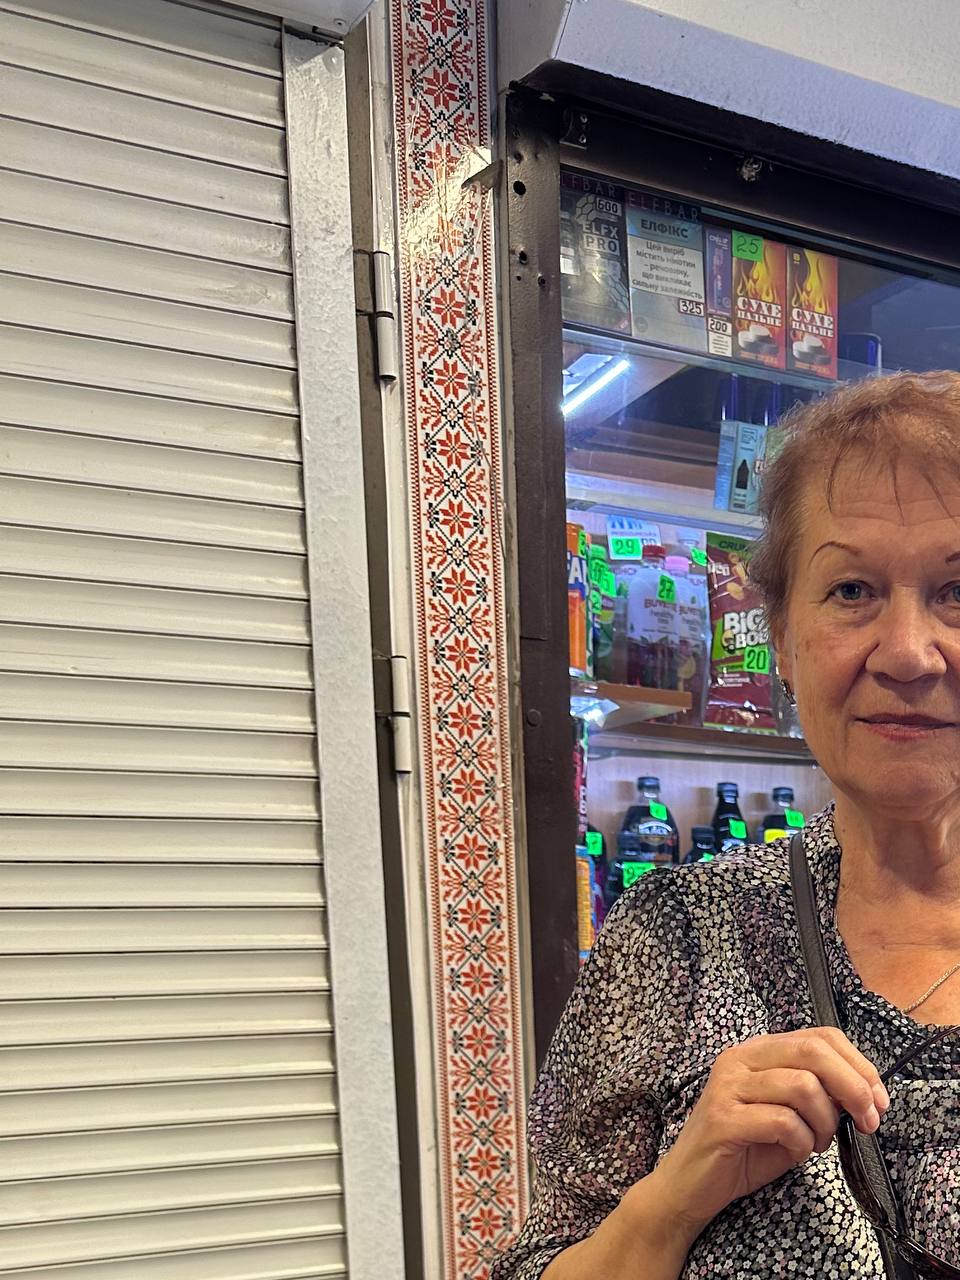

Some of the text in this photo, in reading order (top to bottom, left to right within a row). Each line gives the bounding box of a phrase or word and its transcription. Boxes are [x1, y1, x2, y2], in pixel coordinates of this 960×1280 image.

[560, 175, 616, 198] LFBAR
[582, 222, 618, 239] ELFX
[641, 220, 688, 239] ЕЛФІКС
[585, 235, 617, 253] PRO
[737, 236, 759, 254] 25
[681, 300, 702, 314] 325
[737, 297, 782, 318] СУХЕ
[710, 319, 728, 332] 200
[737, 310, 782, 327] ПАЛЬНЕ
[792, 308, 834, 329] СУХЕ
[792, 321, 834, 337] ПАЛЬНЕ
[615, 539, 635, 555] 29
[746, 649, 767, 670] 20
